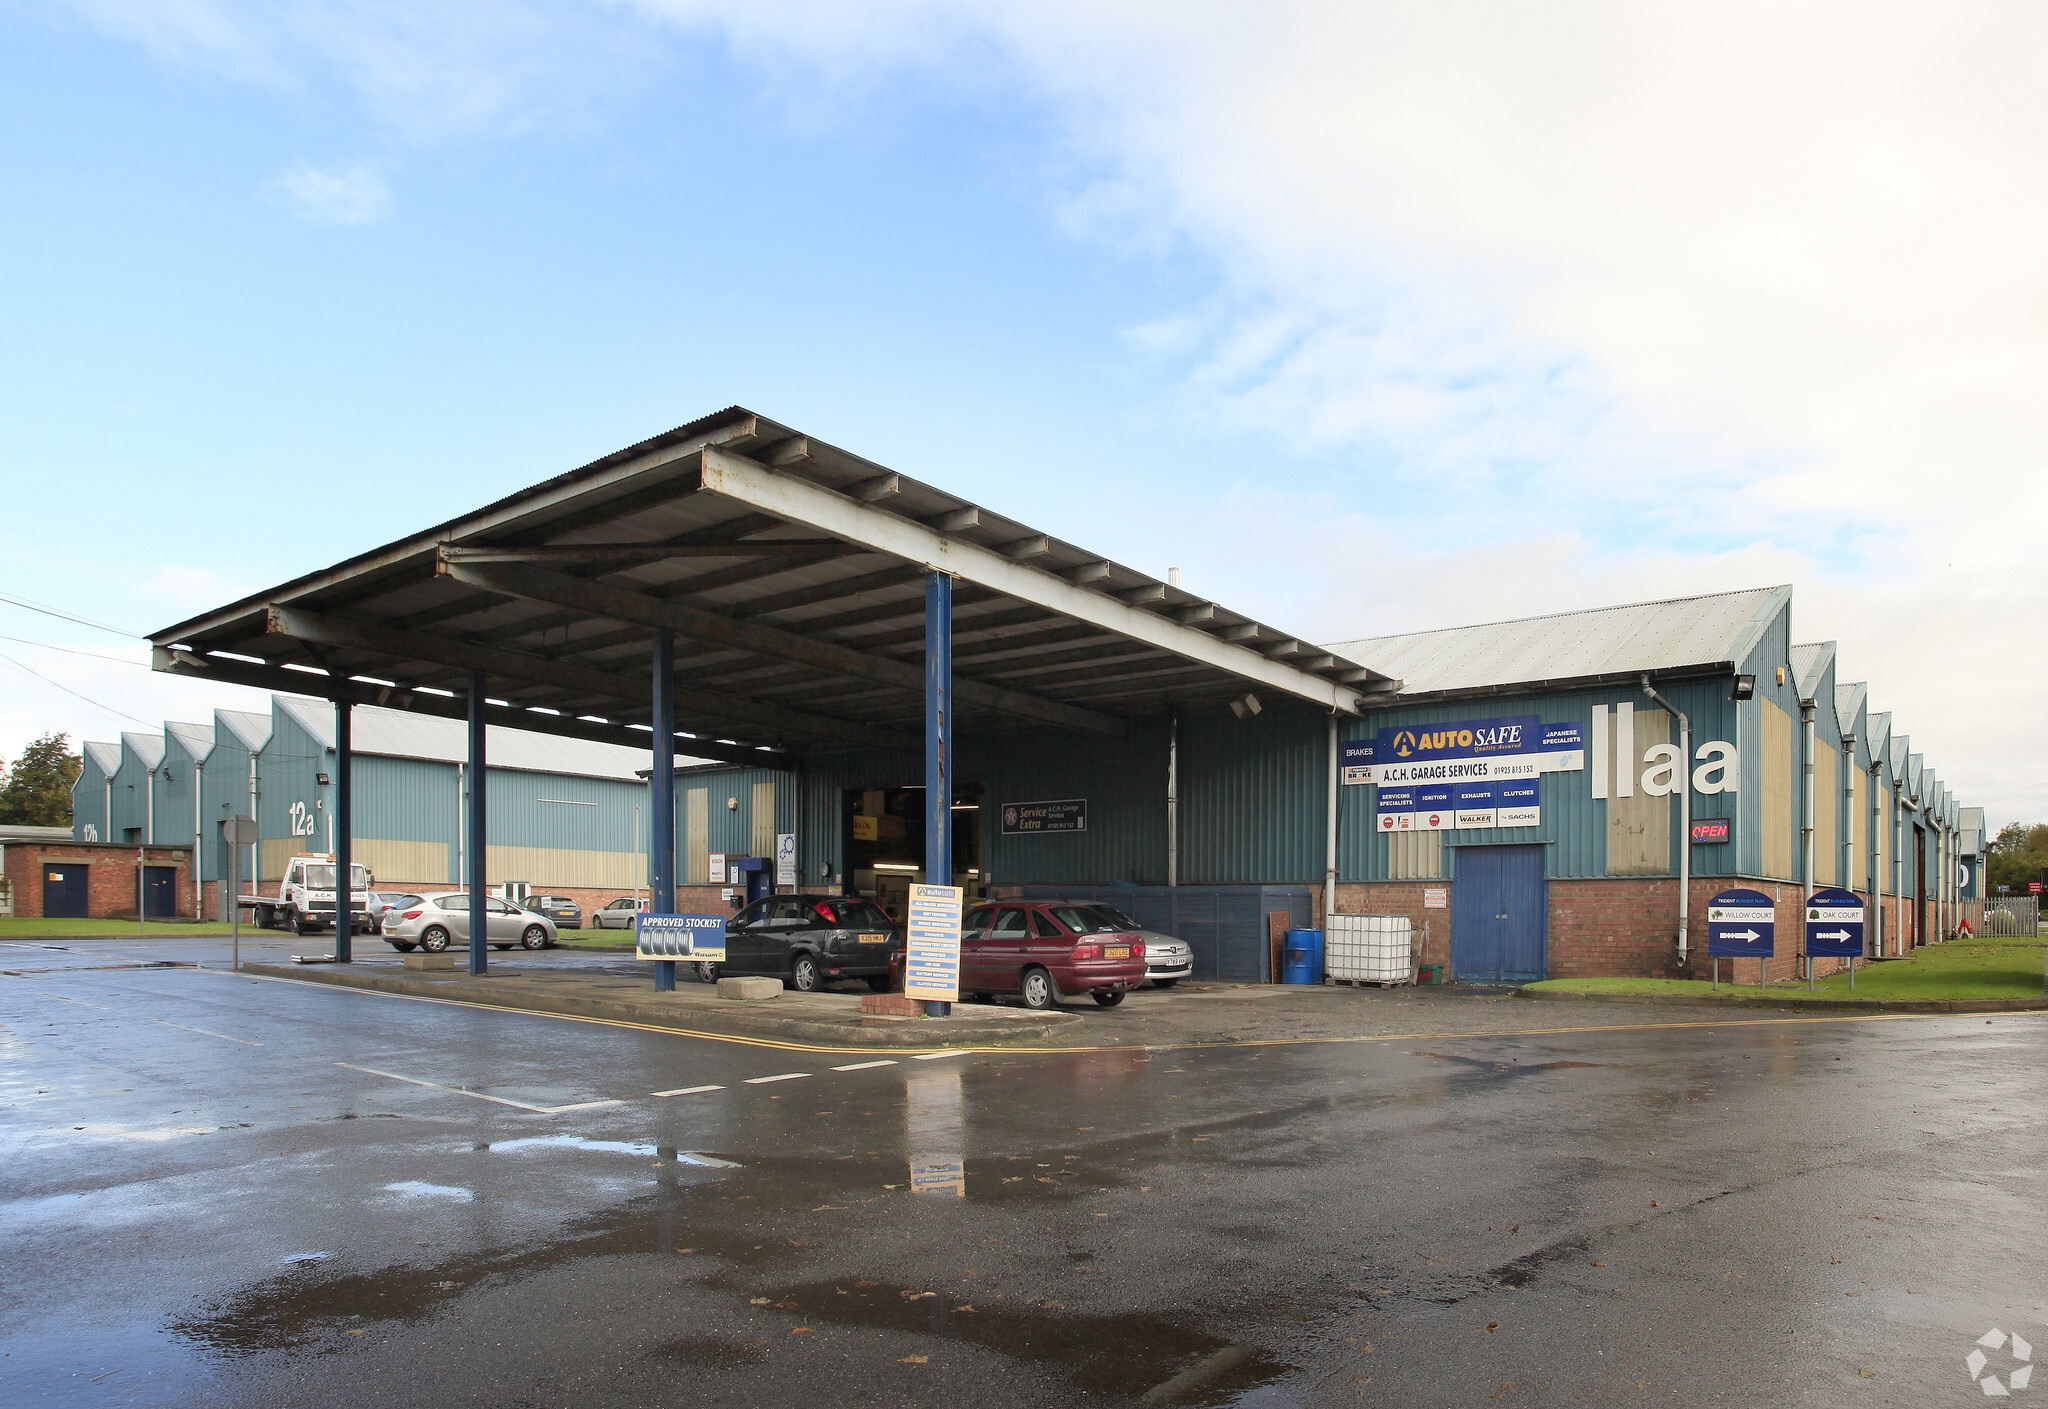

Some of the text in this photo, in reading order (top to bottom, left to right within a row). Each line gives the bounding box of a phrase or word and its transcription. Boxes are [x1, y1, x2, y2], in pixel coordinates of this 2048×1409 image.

[1418, 725, 1522, 750] AUTO SAFE
[1546, 729, 1577, 737] JAPANESE
[1542, 736, 1581, 745] SPECIALISTS
[1346, 747, 1374, 757] BRAKES
[1474, 742, 1522, 753] Quality Assured
[1383, 769, 1409, 781] A.C.H.
[1411, 765, 1446, 780] GARAGE
[1448, 763, 1488, 778] SERVICES
[1494, 766, 1511, 775] 01925
[1511, 765, 1522, 774] 815
[1523, 764, 1534, 773] 152
[1503, 789, 1534, 797] CLUTCHES
[1020, 807, 1047, 818] Service
[289, 801, 315, 836] 12a
[1459, 815, 1492, 823] WALKER
[1020, 819, 1041, 830] Extra
[1691, 825, 1728, 838] OPEN
[1724, 911, 1751, 919] WILLOW
[641, 917, 721, 928] APPROVED STOCKIST
